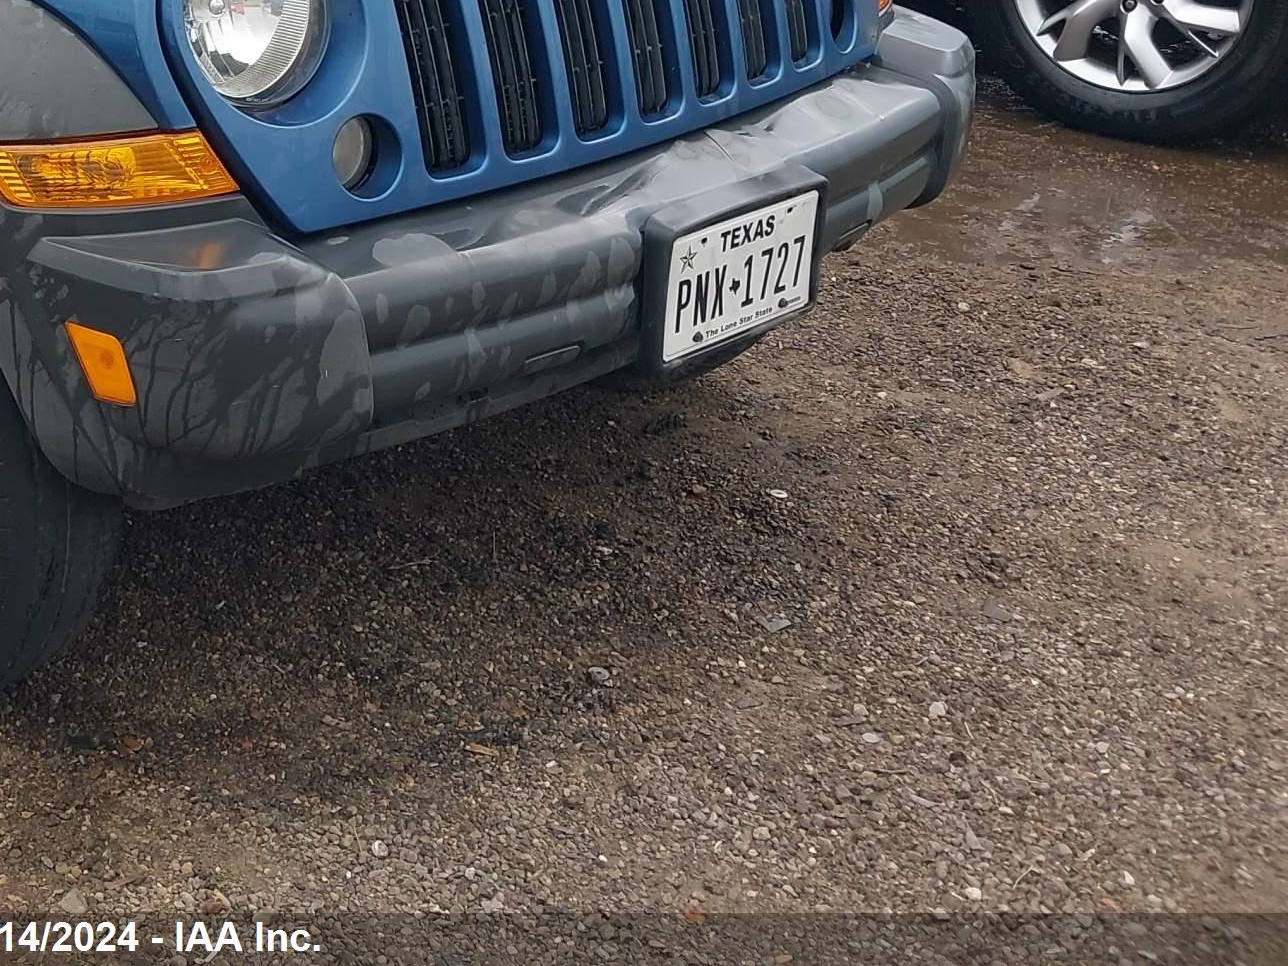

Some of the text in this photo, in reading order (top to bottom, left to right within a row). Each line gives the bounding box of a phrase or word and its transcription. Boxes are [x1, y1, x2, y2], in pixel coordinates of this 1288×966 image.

[720, 214, 776, 253] TEXAS
[705, 306, 774, 339] The Lone Star State
